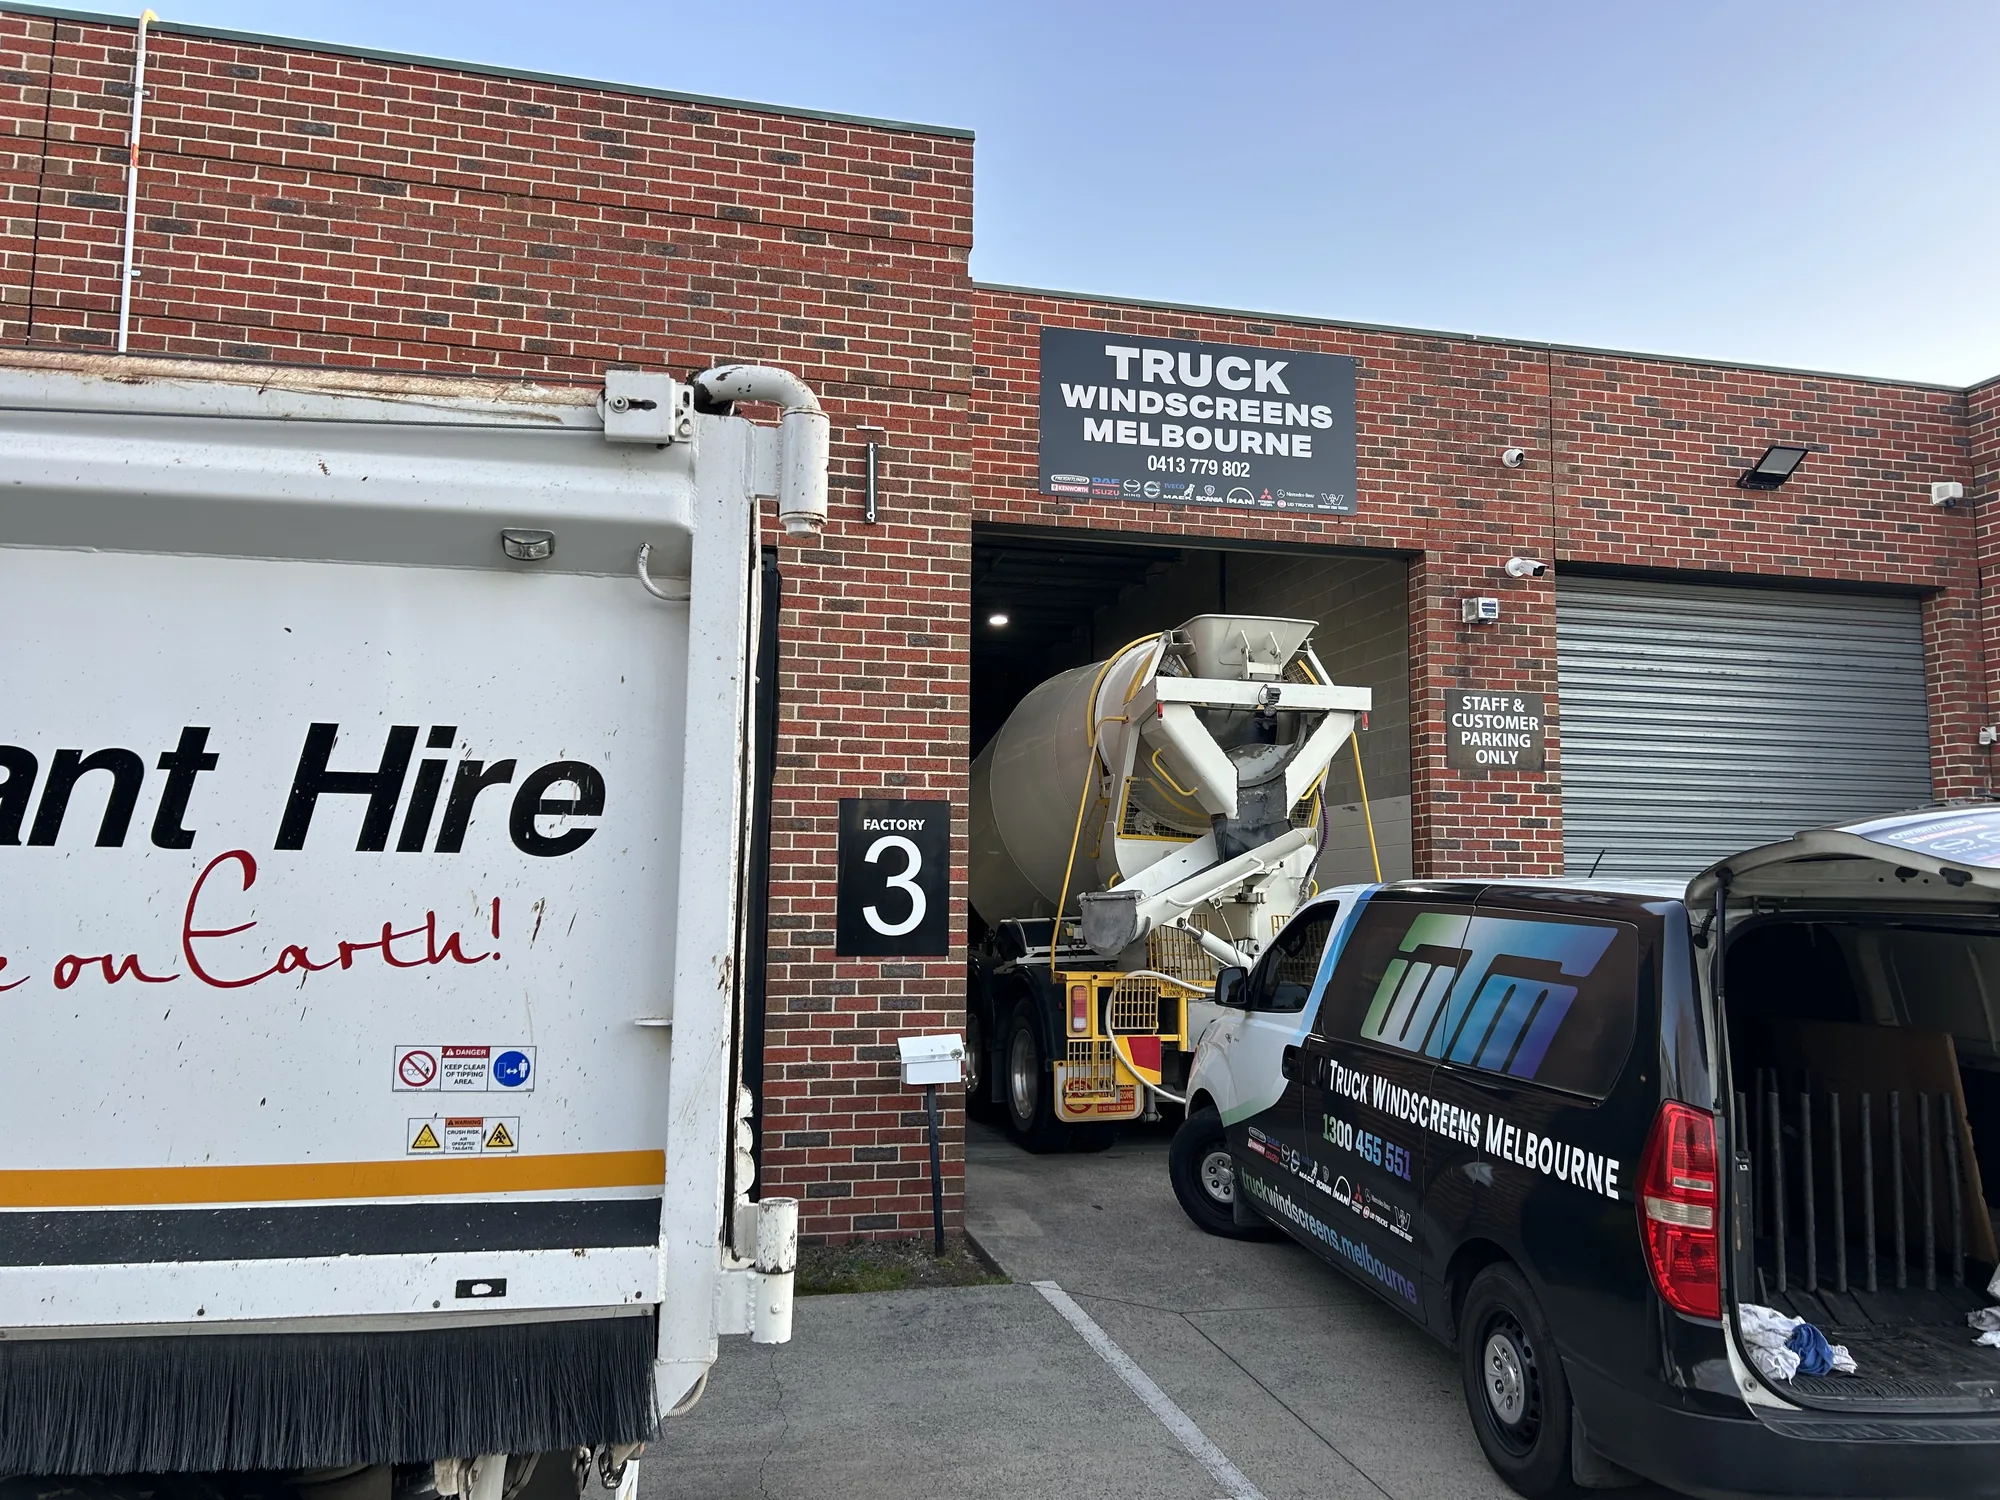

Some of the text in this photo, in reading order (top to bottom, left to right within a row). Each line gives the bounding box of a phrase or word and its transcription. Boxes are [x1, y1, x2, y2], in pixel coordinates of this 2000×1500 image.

[1104, 344, 1291, 395] TRUCK
[1059, 382, 1334, 430] WINDSCREENS
[1083, 417, 1312, 459] MELBOURNE
[1147, 455, 1251, 478] 0413 779 802
[1058, 484, 1089, 493] KENWORTH
[1092, 488, 1120, 496] ISUZU
[1164, 482, 1185, 490] IVECO
[1462, 695, 1525, 713] STAFF &
[1451, 713, 1539, 731] CUSTOMER
[1461, 731, 1531, 748] PARKING
[1475, 749, 1519, 765] ONLY
[273, 722, 607, 858] Hire
[863, 818, 926, 831] FACTORY
[862, 835, 927, 936] 3
[54, 954, 180, 989] on
[182, 849, 501, 989] Earth!
[1120, 1090, 1134, 1099] ZONE
[1330, 1059, 1620, 1200] TRUCK WINDSCREENS MELBOURNE
[1322, 1113, 1411, 1181] 1300 455 551
[1241, 1166, 1418, 1305] truckwindscreens.melbourne
